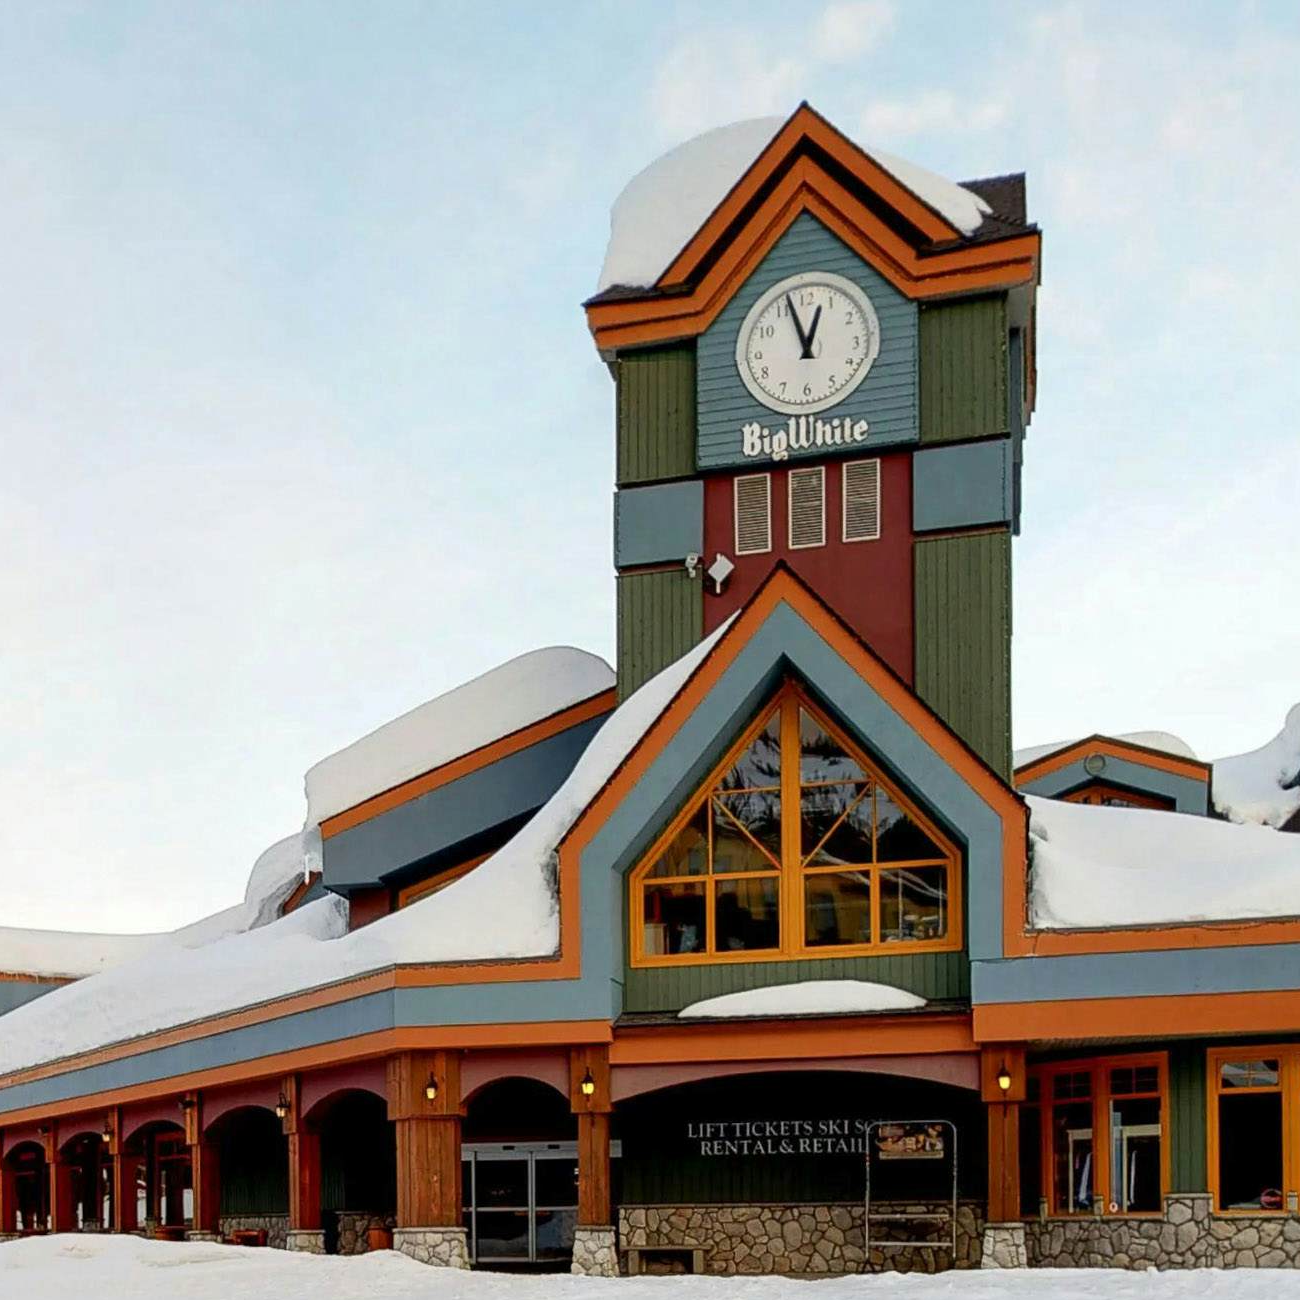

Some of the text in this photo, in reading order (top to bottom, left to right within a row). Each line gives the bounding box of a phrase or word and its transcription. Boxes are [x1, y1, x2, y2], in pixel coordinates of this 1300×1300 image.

[800, 292, 814, 307] 12
[776, 301, 789, 318] 11
[845, 312, 853, 325] 2
[760, 325, 775, 338] 10
[852, 336, 860, 350] 3
[761, 366, 769, 379] 8
[779, 382, 787, 395] 7
[828, 375, 836, 389] 5
[803, 383, 812, 397] 6
[688, 1123, 728, 1138] LIFT
[732, 1120, 813, 1137] TICKETS
[819, 1119, 849, 1135] SKI
[701, 1137, 866, 1155] RENTAL & RETAIL
